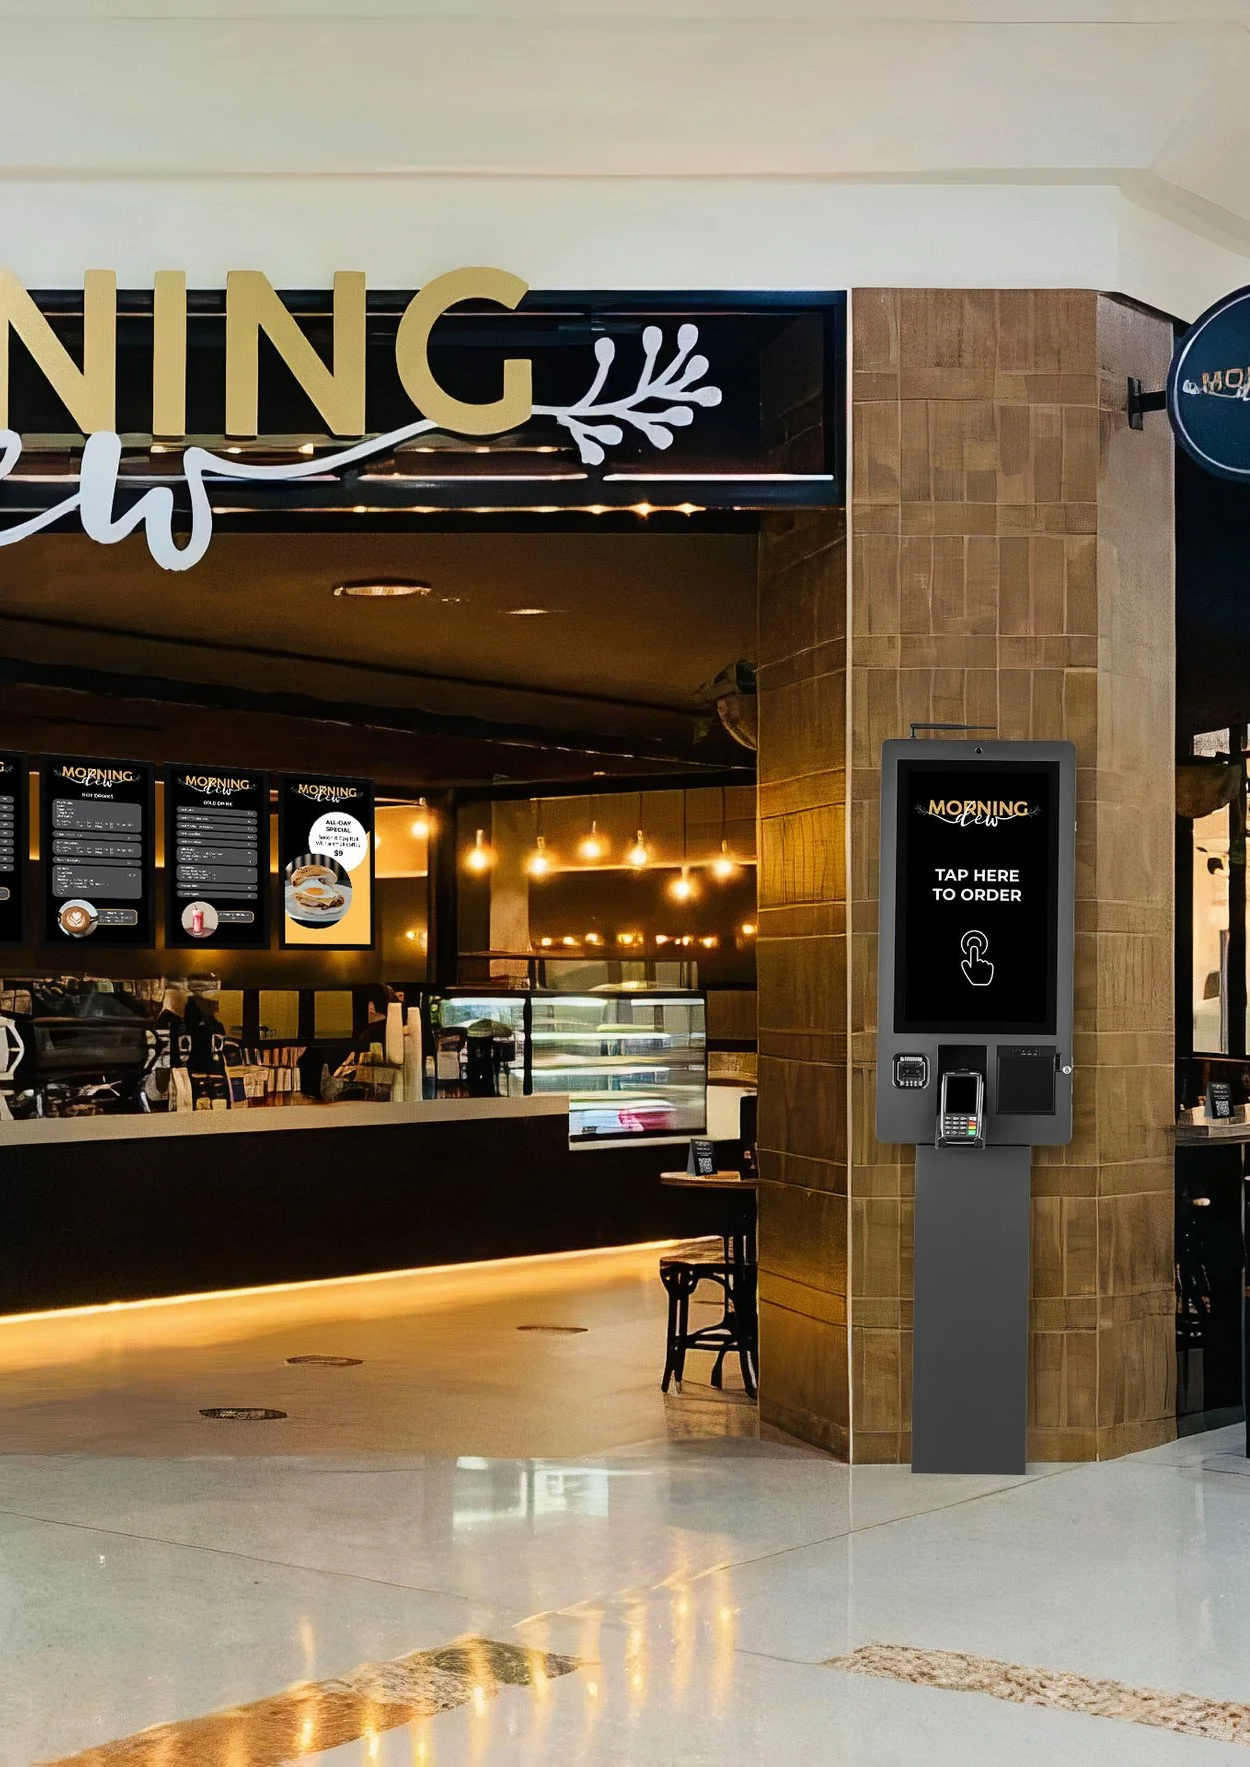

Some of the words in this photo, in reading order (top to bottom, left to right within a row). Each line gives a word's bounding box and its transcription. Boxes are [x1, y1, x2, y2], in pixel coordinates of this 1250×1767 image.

[61, 766, 134, 782] MORNING
[185, 775, 250, 790] MORNING
[297, 783, 357, 798] MORNING
[928, 799, 1028, 817] MORNING
[334, 849, 344, 857] $9
[935, 868, 968, 883] TAP
[974, 868, 1019, 883] HERE
[932, 888, 955, 902] TO
[960, 888, 1022, 902] ORDER
